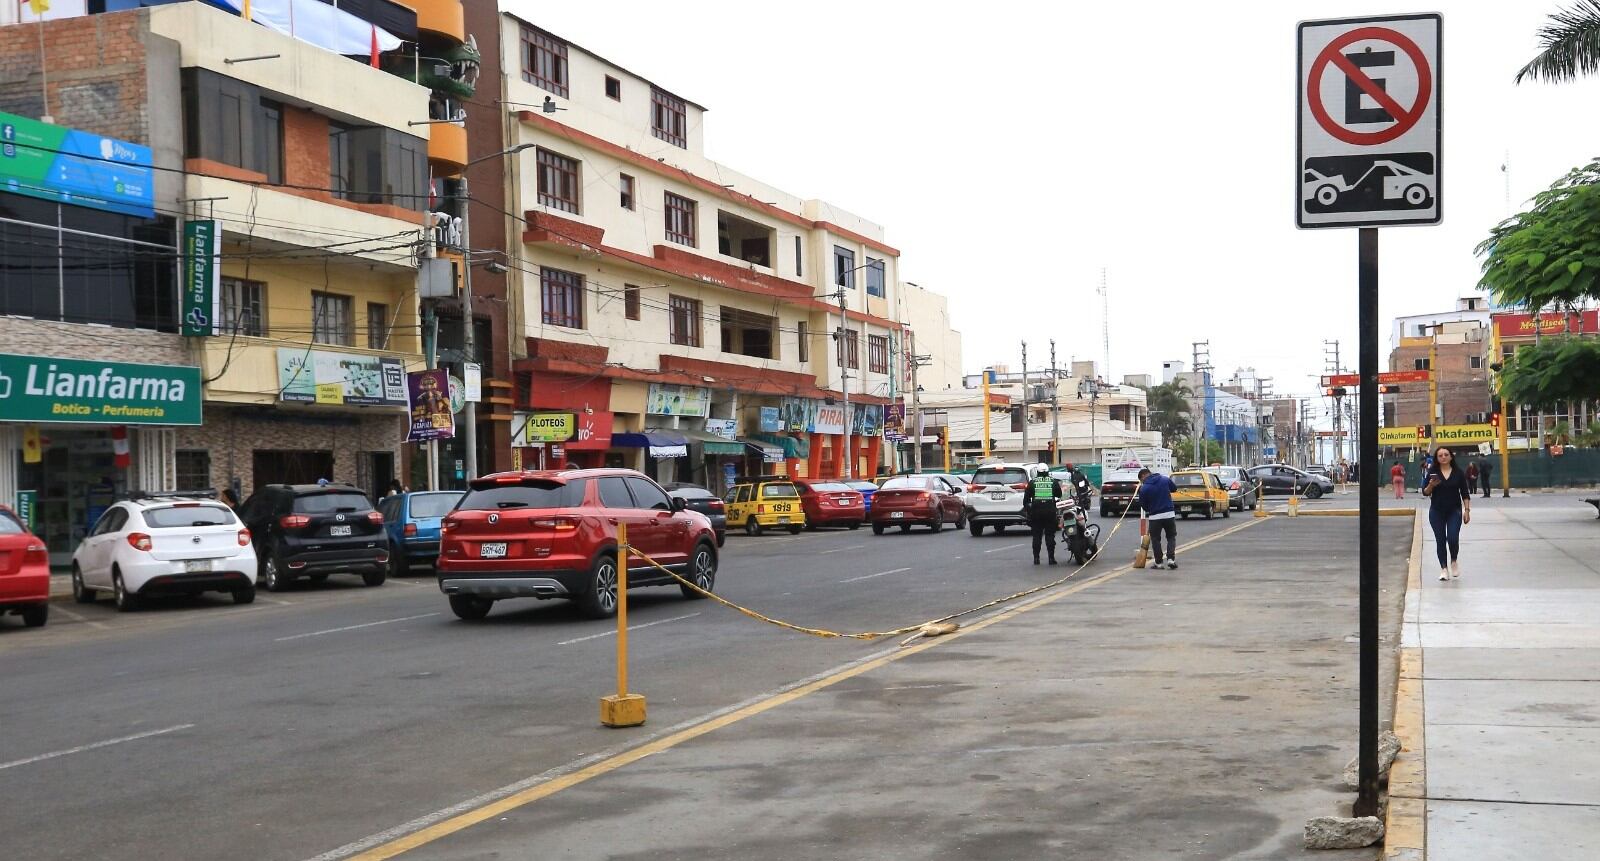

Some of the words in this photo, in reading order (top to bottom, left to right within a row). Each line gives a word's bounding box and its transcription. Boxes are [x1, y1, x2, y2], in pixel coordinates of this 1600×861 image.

[1345, 51, 1395, 124] E
[195, 225, 207, 303] Lianfarma
[25, 364, 186, 402] Lianfarma
[52, 403, 91, 415] Botica
[102, 405, 165, 417] Perfumeria
[531, 418, 565, 428] PLOTEOS
[1436, 428, 1493, 439] nkafarma
[772, 503, 792, 512] 1919
